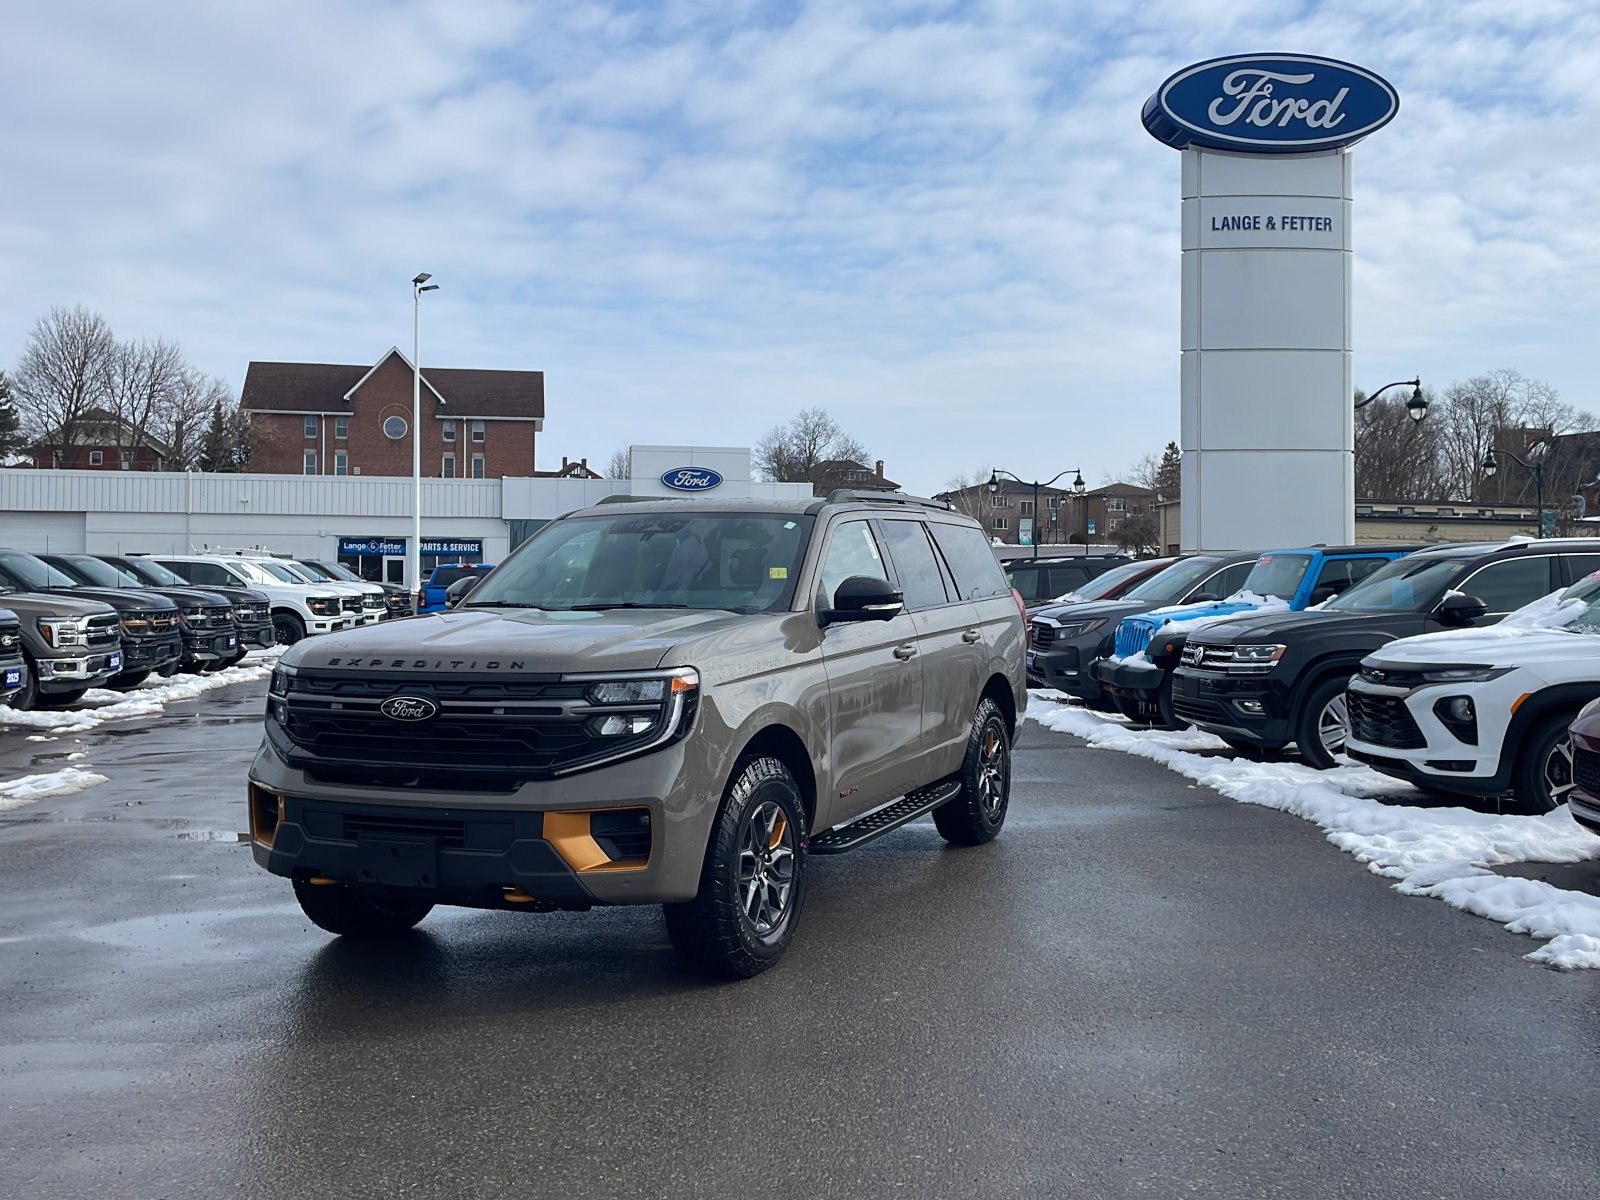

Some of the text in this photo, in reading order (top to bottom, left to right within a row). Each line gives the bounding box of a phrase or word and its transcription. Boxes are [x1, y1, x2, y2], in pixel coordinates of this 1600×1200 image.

[1208, 69, 1349, 129] Ford
[1212, 216, 1333, 232] LANGE & FETTER
[674, 470, 710, 487] Ford
[343, 542, 367, 550] Lange
[380, 542, 402, 550] Fetter
[419, 543, 480, 552] PARTS & SERVICE
[328, 658, 525, 670] EXPEDITION
[6, 672, 20, 683] 2025
[390, 700, 424, 718] Ford
